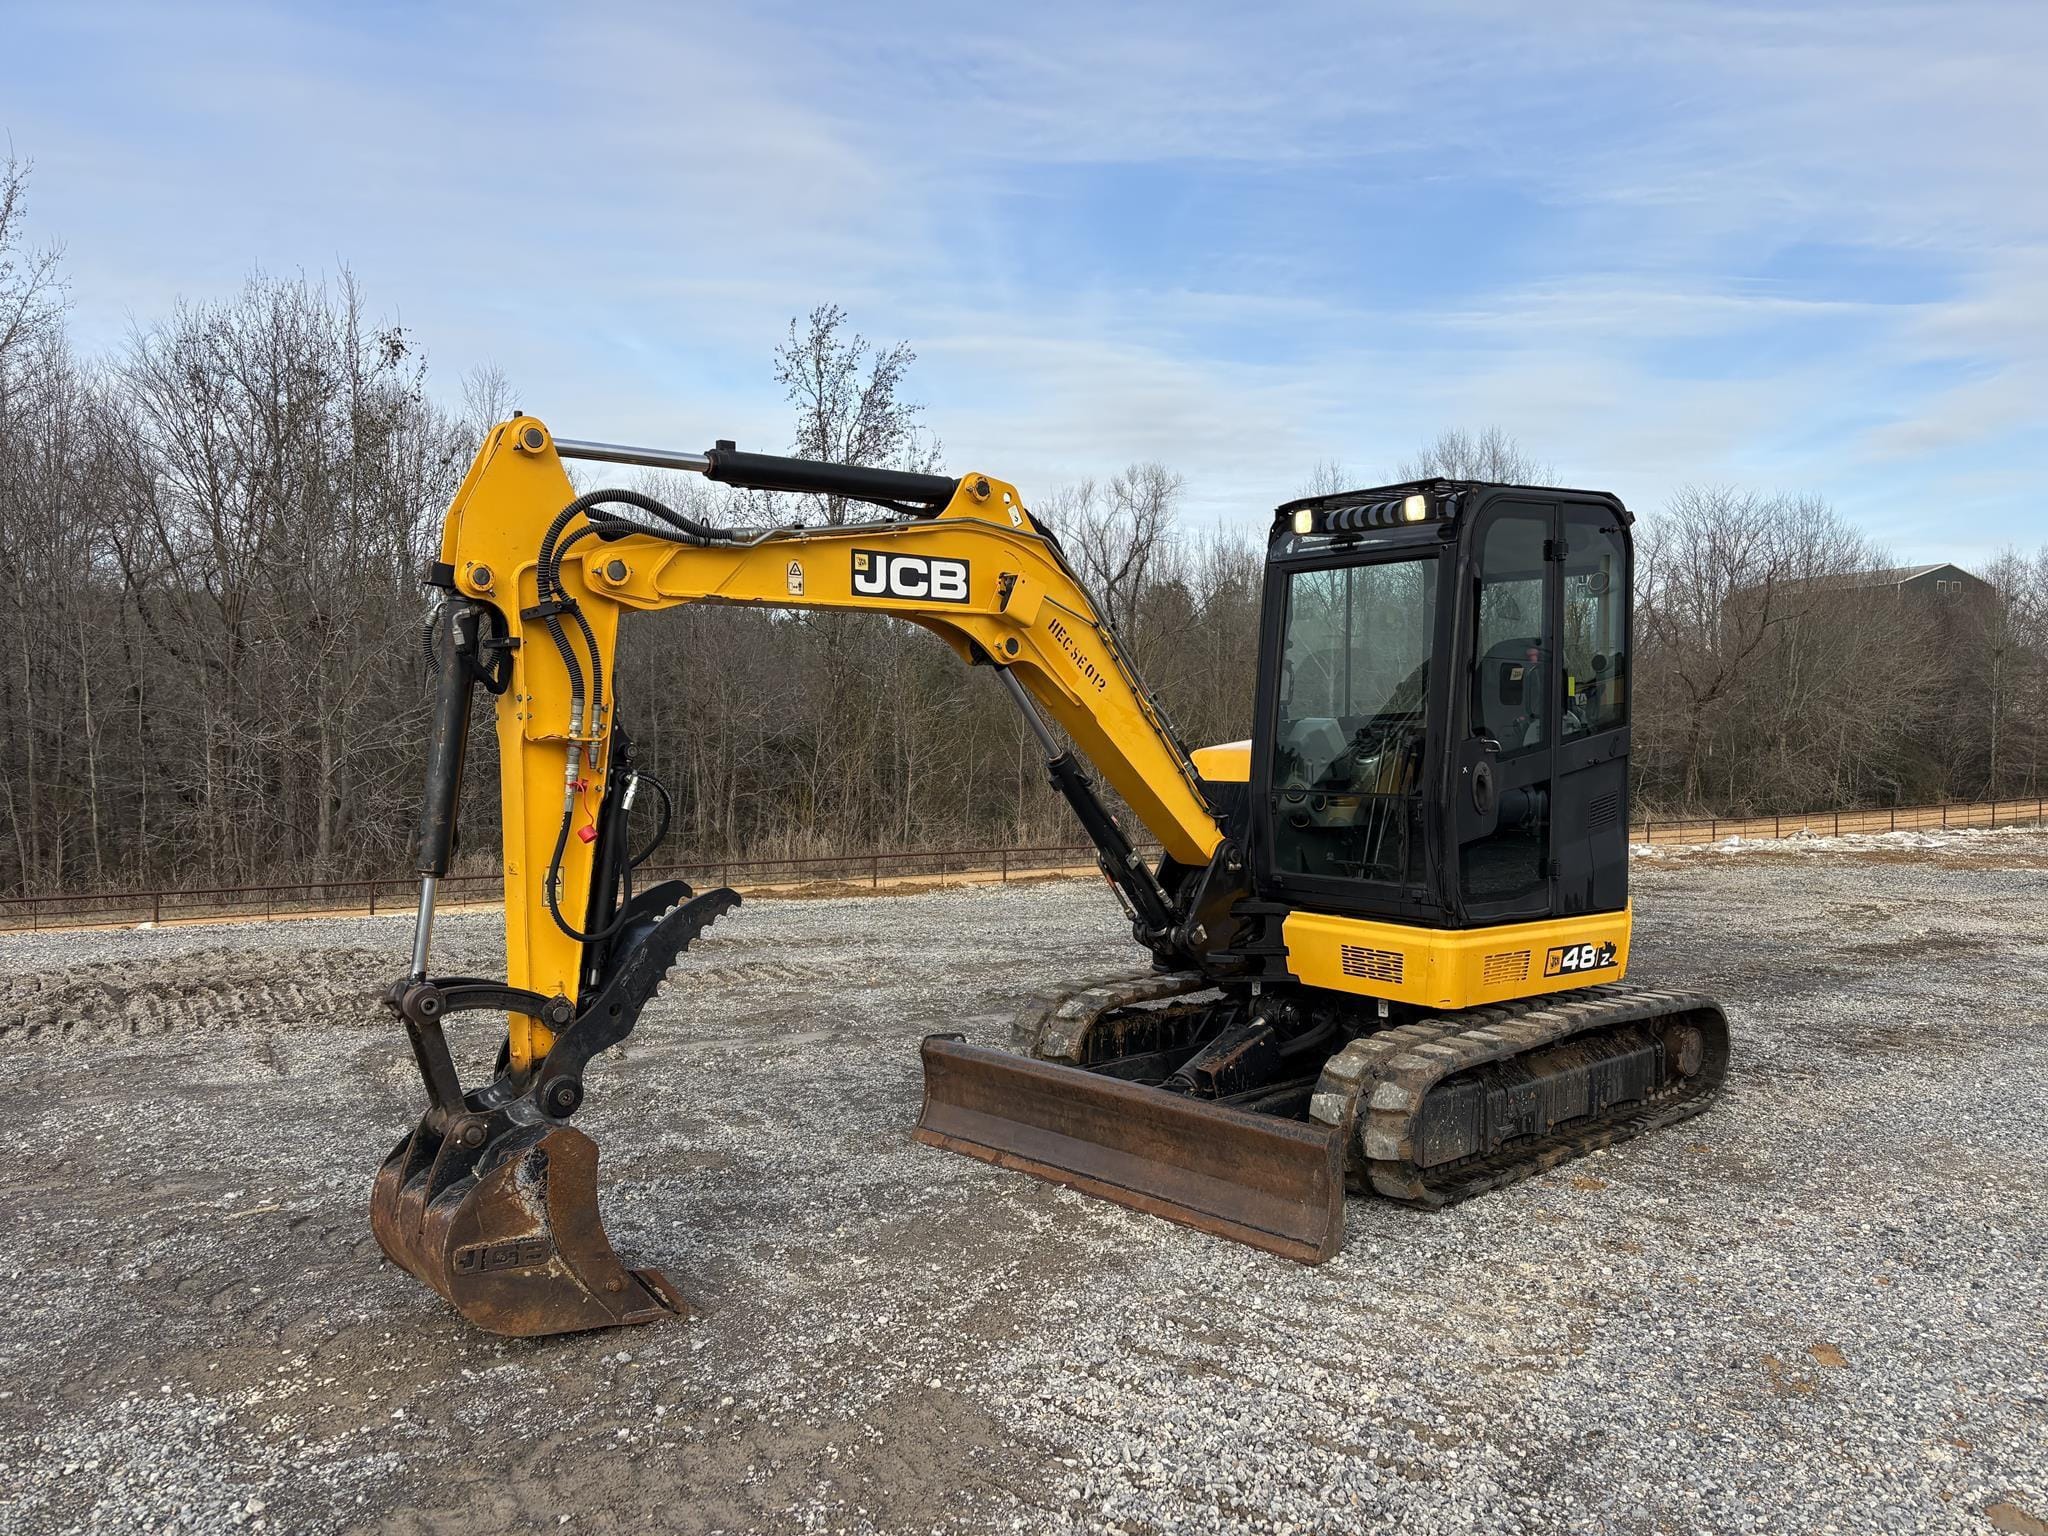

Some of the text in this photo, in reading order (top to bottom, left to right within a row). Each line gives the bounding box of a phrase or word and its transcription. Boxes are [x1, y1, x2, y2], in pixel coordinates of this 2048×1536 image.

[854, 555, 968, 600] JCB
[1562, 945, 1596, 970] 48
[456, 1240, 550, 1275] JCB
